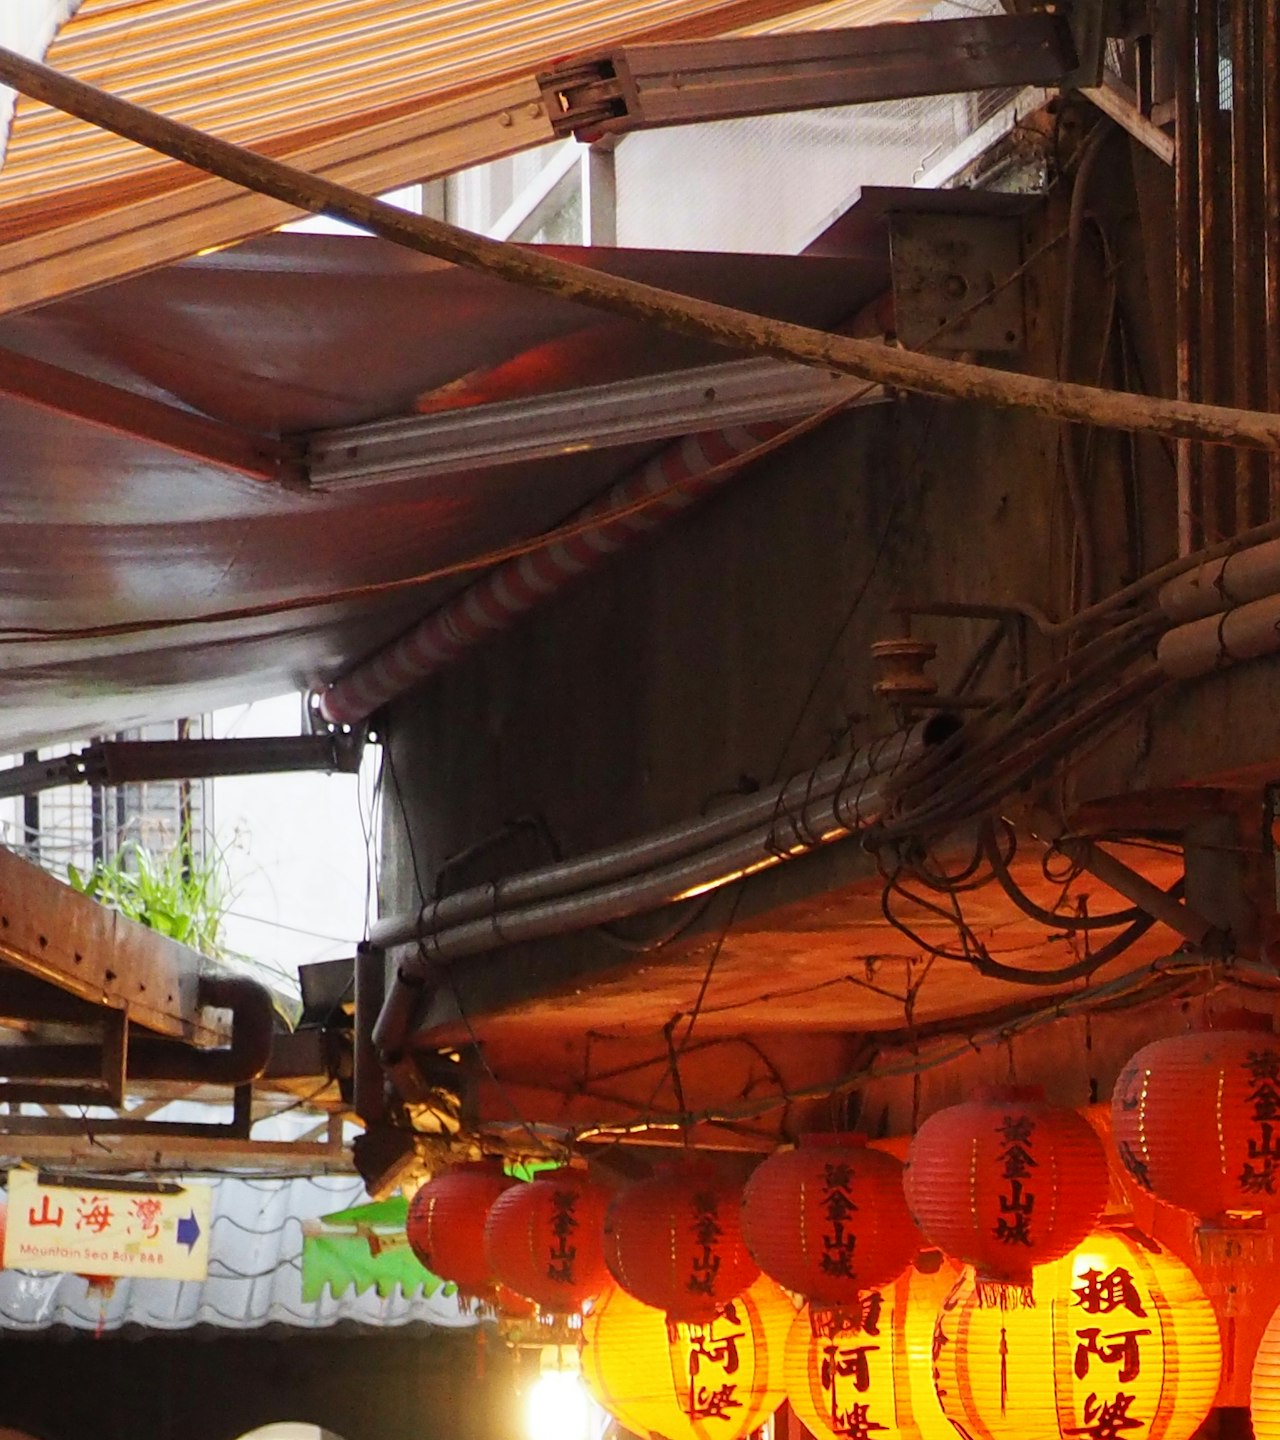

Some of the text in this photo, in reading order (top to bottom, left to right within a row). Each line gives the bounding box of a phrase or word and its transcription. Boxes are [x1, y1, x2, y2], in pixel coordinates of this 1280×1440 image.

[29, 1195, 163, 1239] 山海灣
[819, 1162, 858, 1279] 黃金山城
[992, 1114, 1038, 1248] 黃金山城
[20, 1244, 81, 1259] Mountain
[85, 1249, 108, 1262] Sea
[684, 1302, 746, 1422] 阿婆
